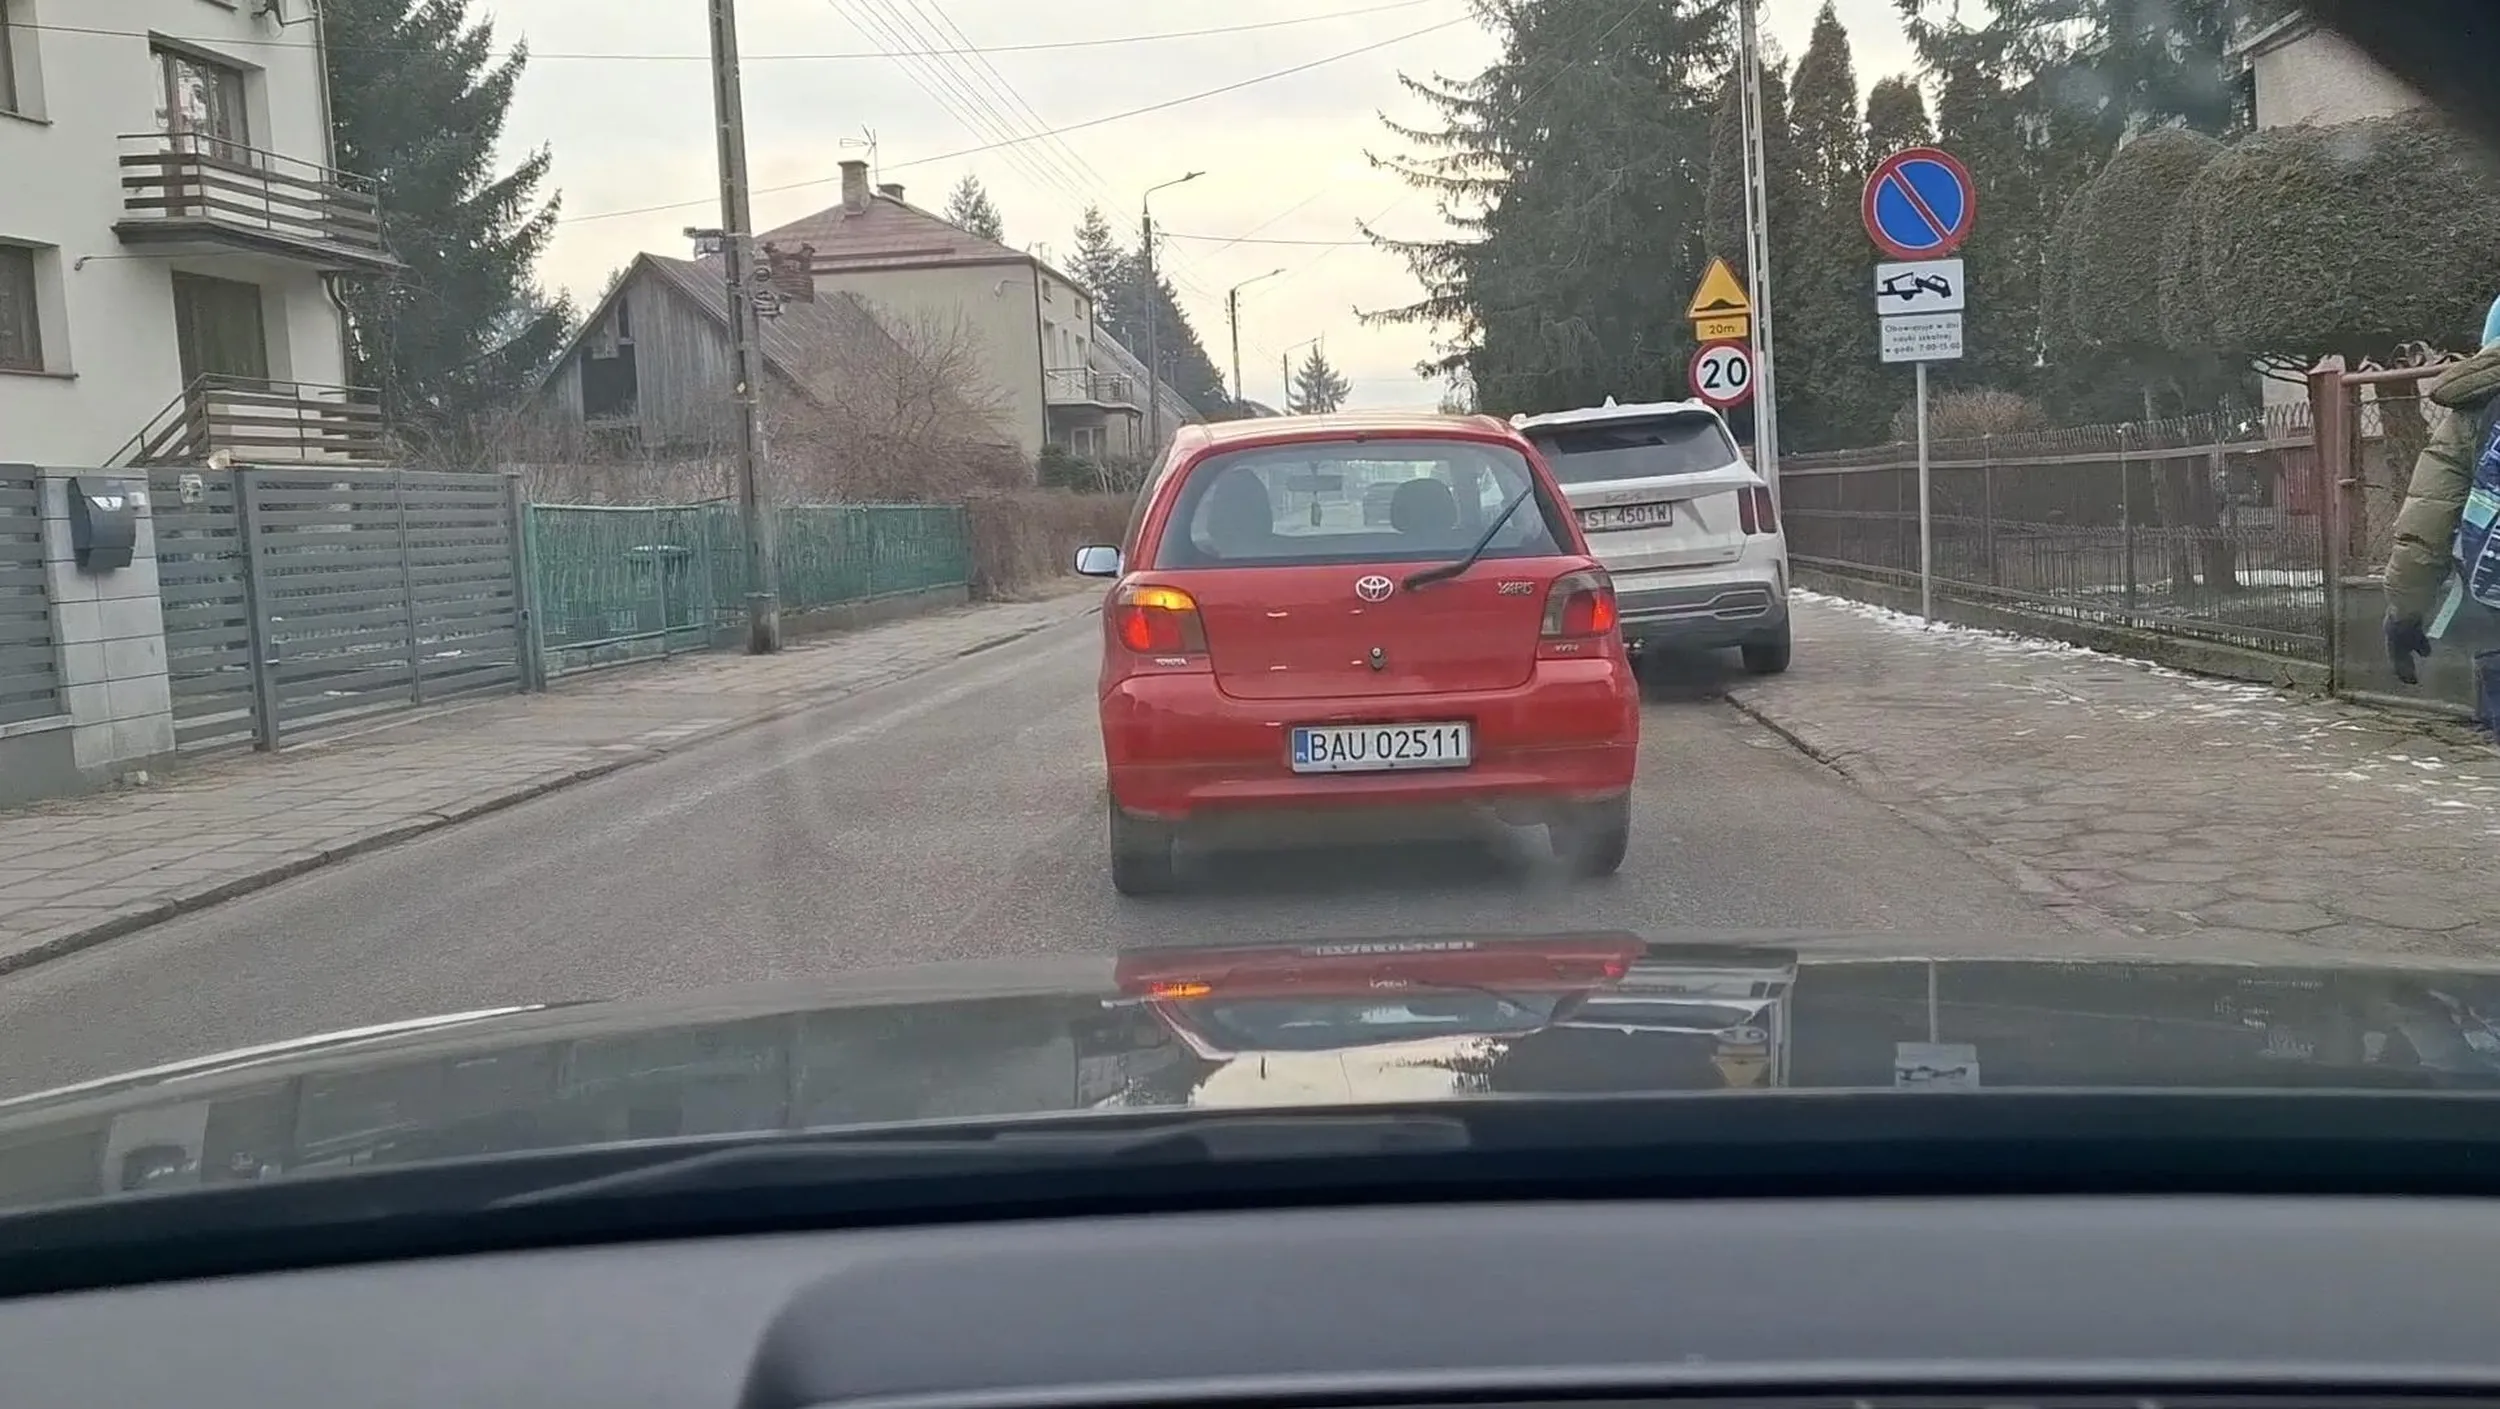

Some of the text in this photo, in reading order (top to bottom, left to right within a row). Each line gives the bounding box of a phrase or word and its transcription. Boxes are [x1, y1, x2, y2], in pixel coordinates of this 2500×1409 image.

[1709, 324, 1736, 335] 20m
[1702, 356, 1748, 389] 20
[1588, 509, 1609, 527] ST
[1496, 580, 1536, 596] YARIS
[1311, 728, 1460, 762] BAU 02511
